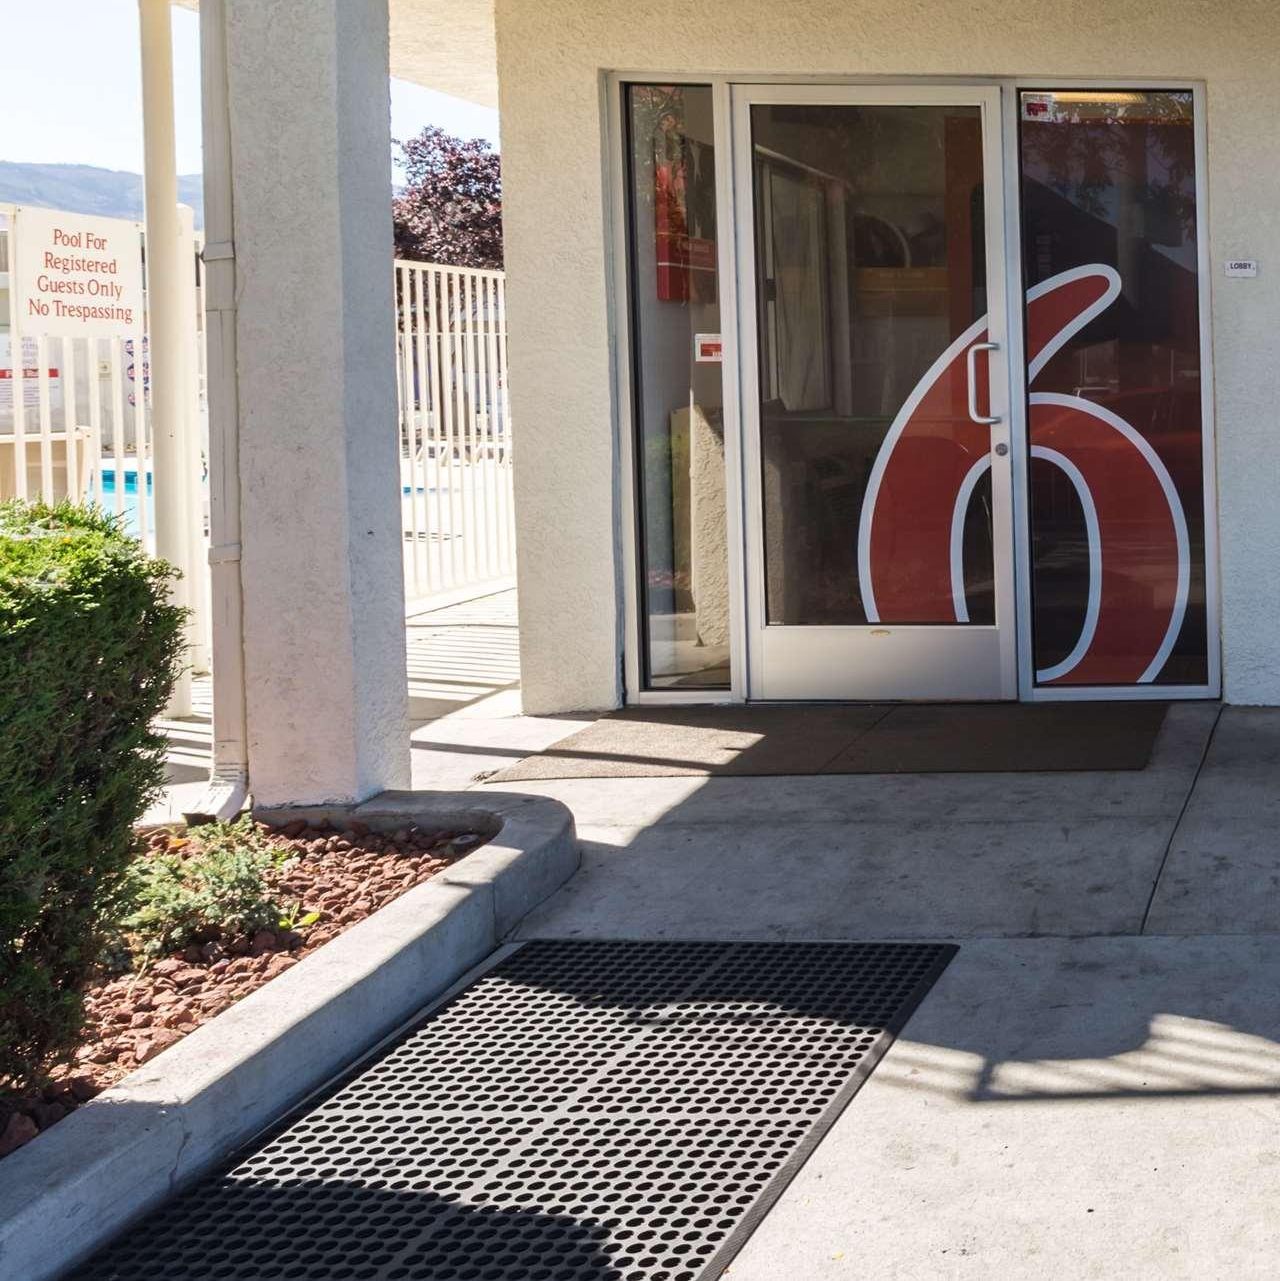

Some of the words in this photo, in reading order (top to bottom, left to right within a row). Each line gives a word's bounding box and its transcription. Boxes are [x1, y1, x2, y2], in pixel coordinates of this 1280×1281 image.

[53, 228, 82, 248] Pool
[86, 232, 108, 250] For
[44, 251, 117, 275] Registered
[1229, 262, 1252, 270] LOBBY
[37, 275, 85, 295] Guests
[87, 279, 123, 301] Only
[28, 298, 50, 316] No
[52, 300, 133, 324] Trespassing
